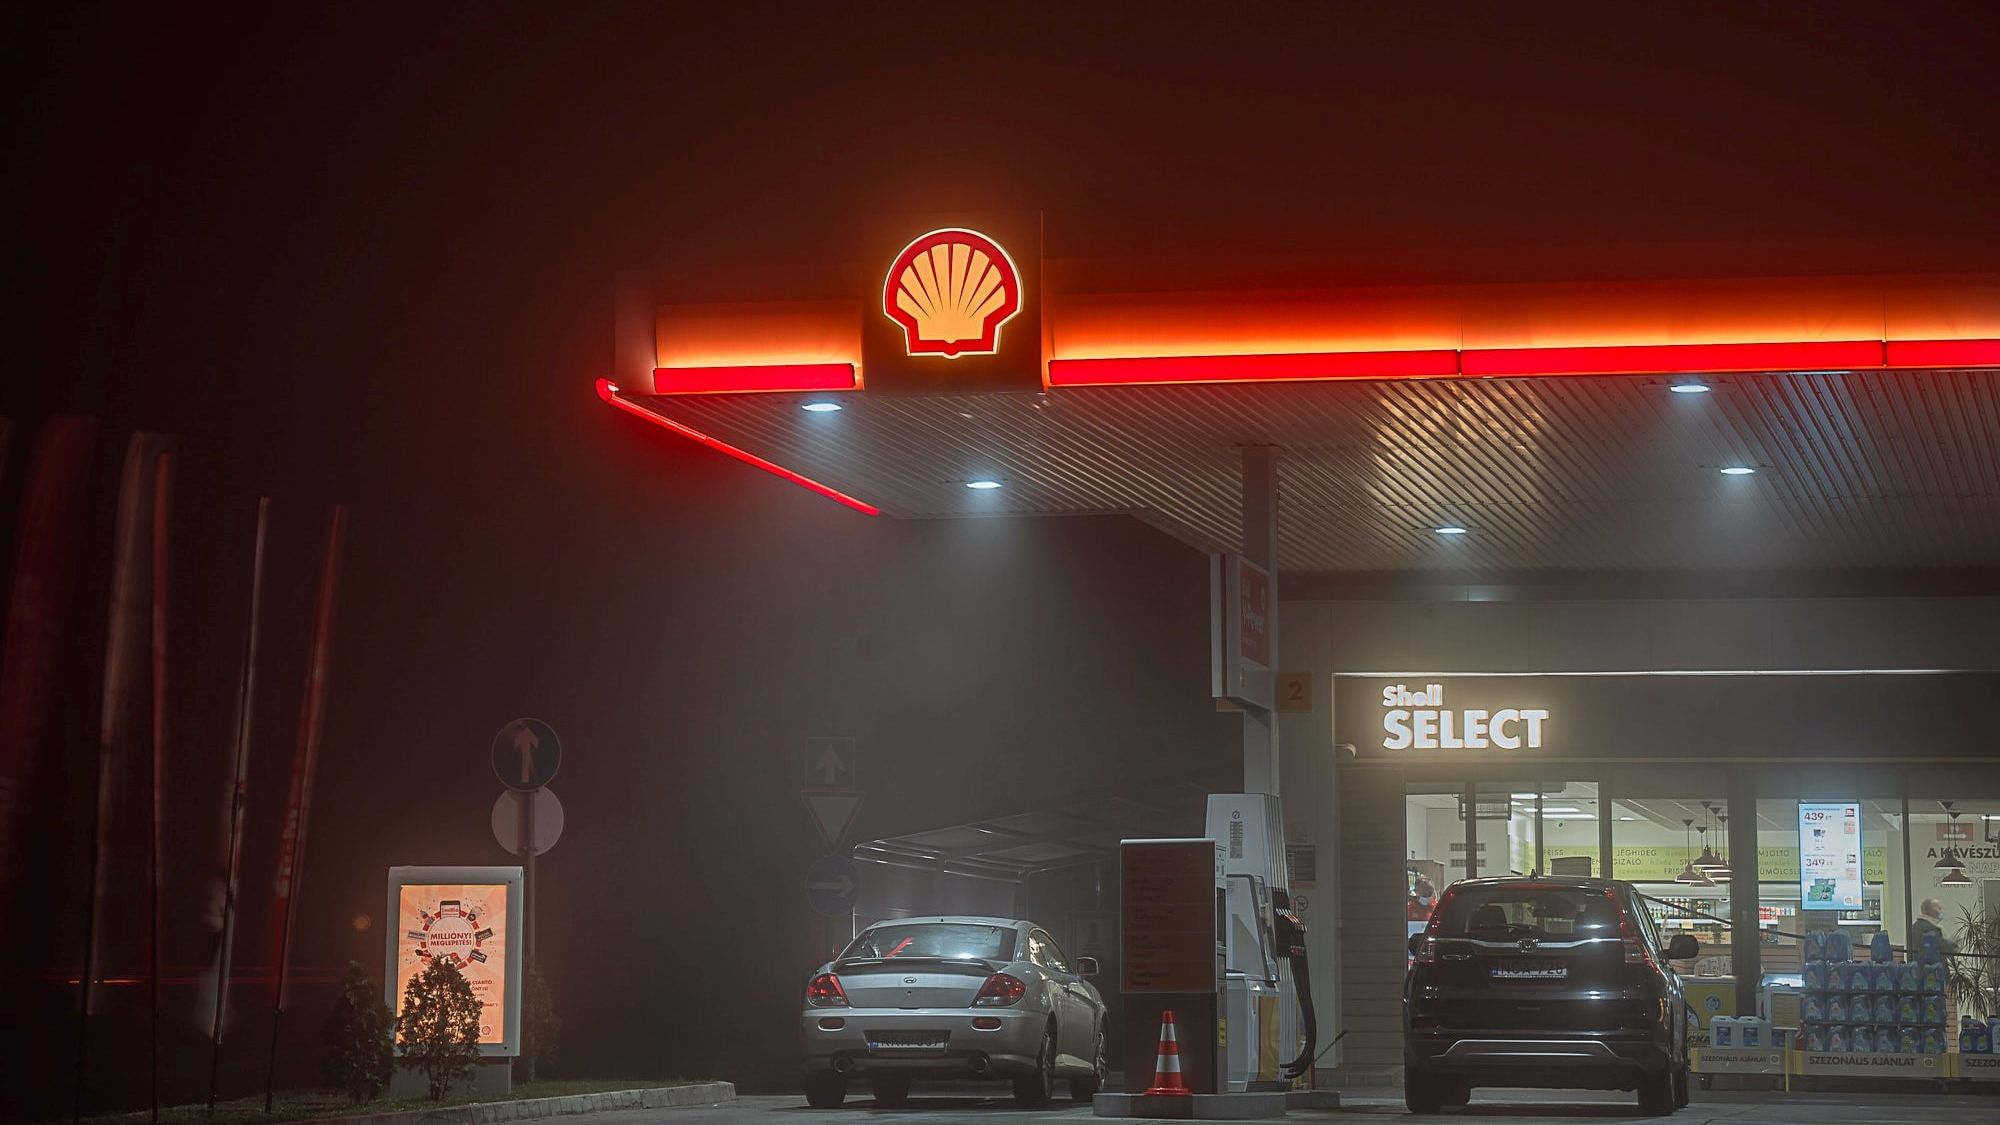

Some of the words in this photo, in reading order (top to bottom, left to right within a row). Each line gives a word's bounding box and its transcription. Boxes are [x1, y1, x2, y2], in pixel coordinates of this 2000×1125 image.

[1287, 681, 1304, 701] 2
[1382, 684, 1443, 707] Shell
[1382, 709, 1550, 750] SELECT
[1927, 847, 1937, 859] A
[1809, 1055, 1869, 1066] SZEZONÁLIS
[1871, 1056, 1917, 1067] AJÁNLAT
[1965, 1058, 2000, 1068] SZEZO
